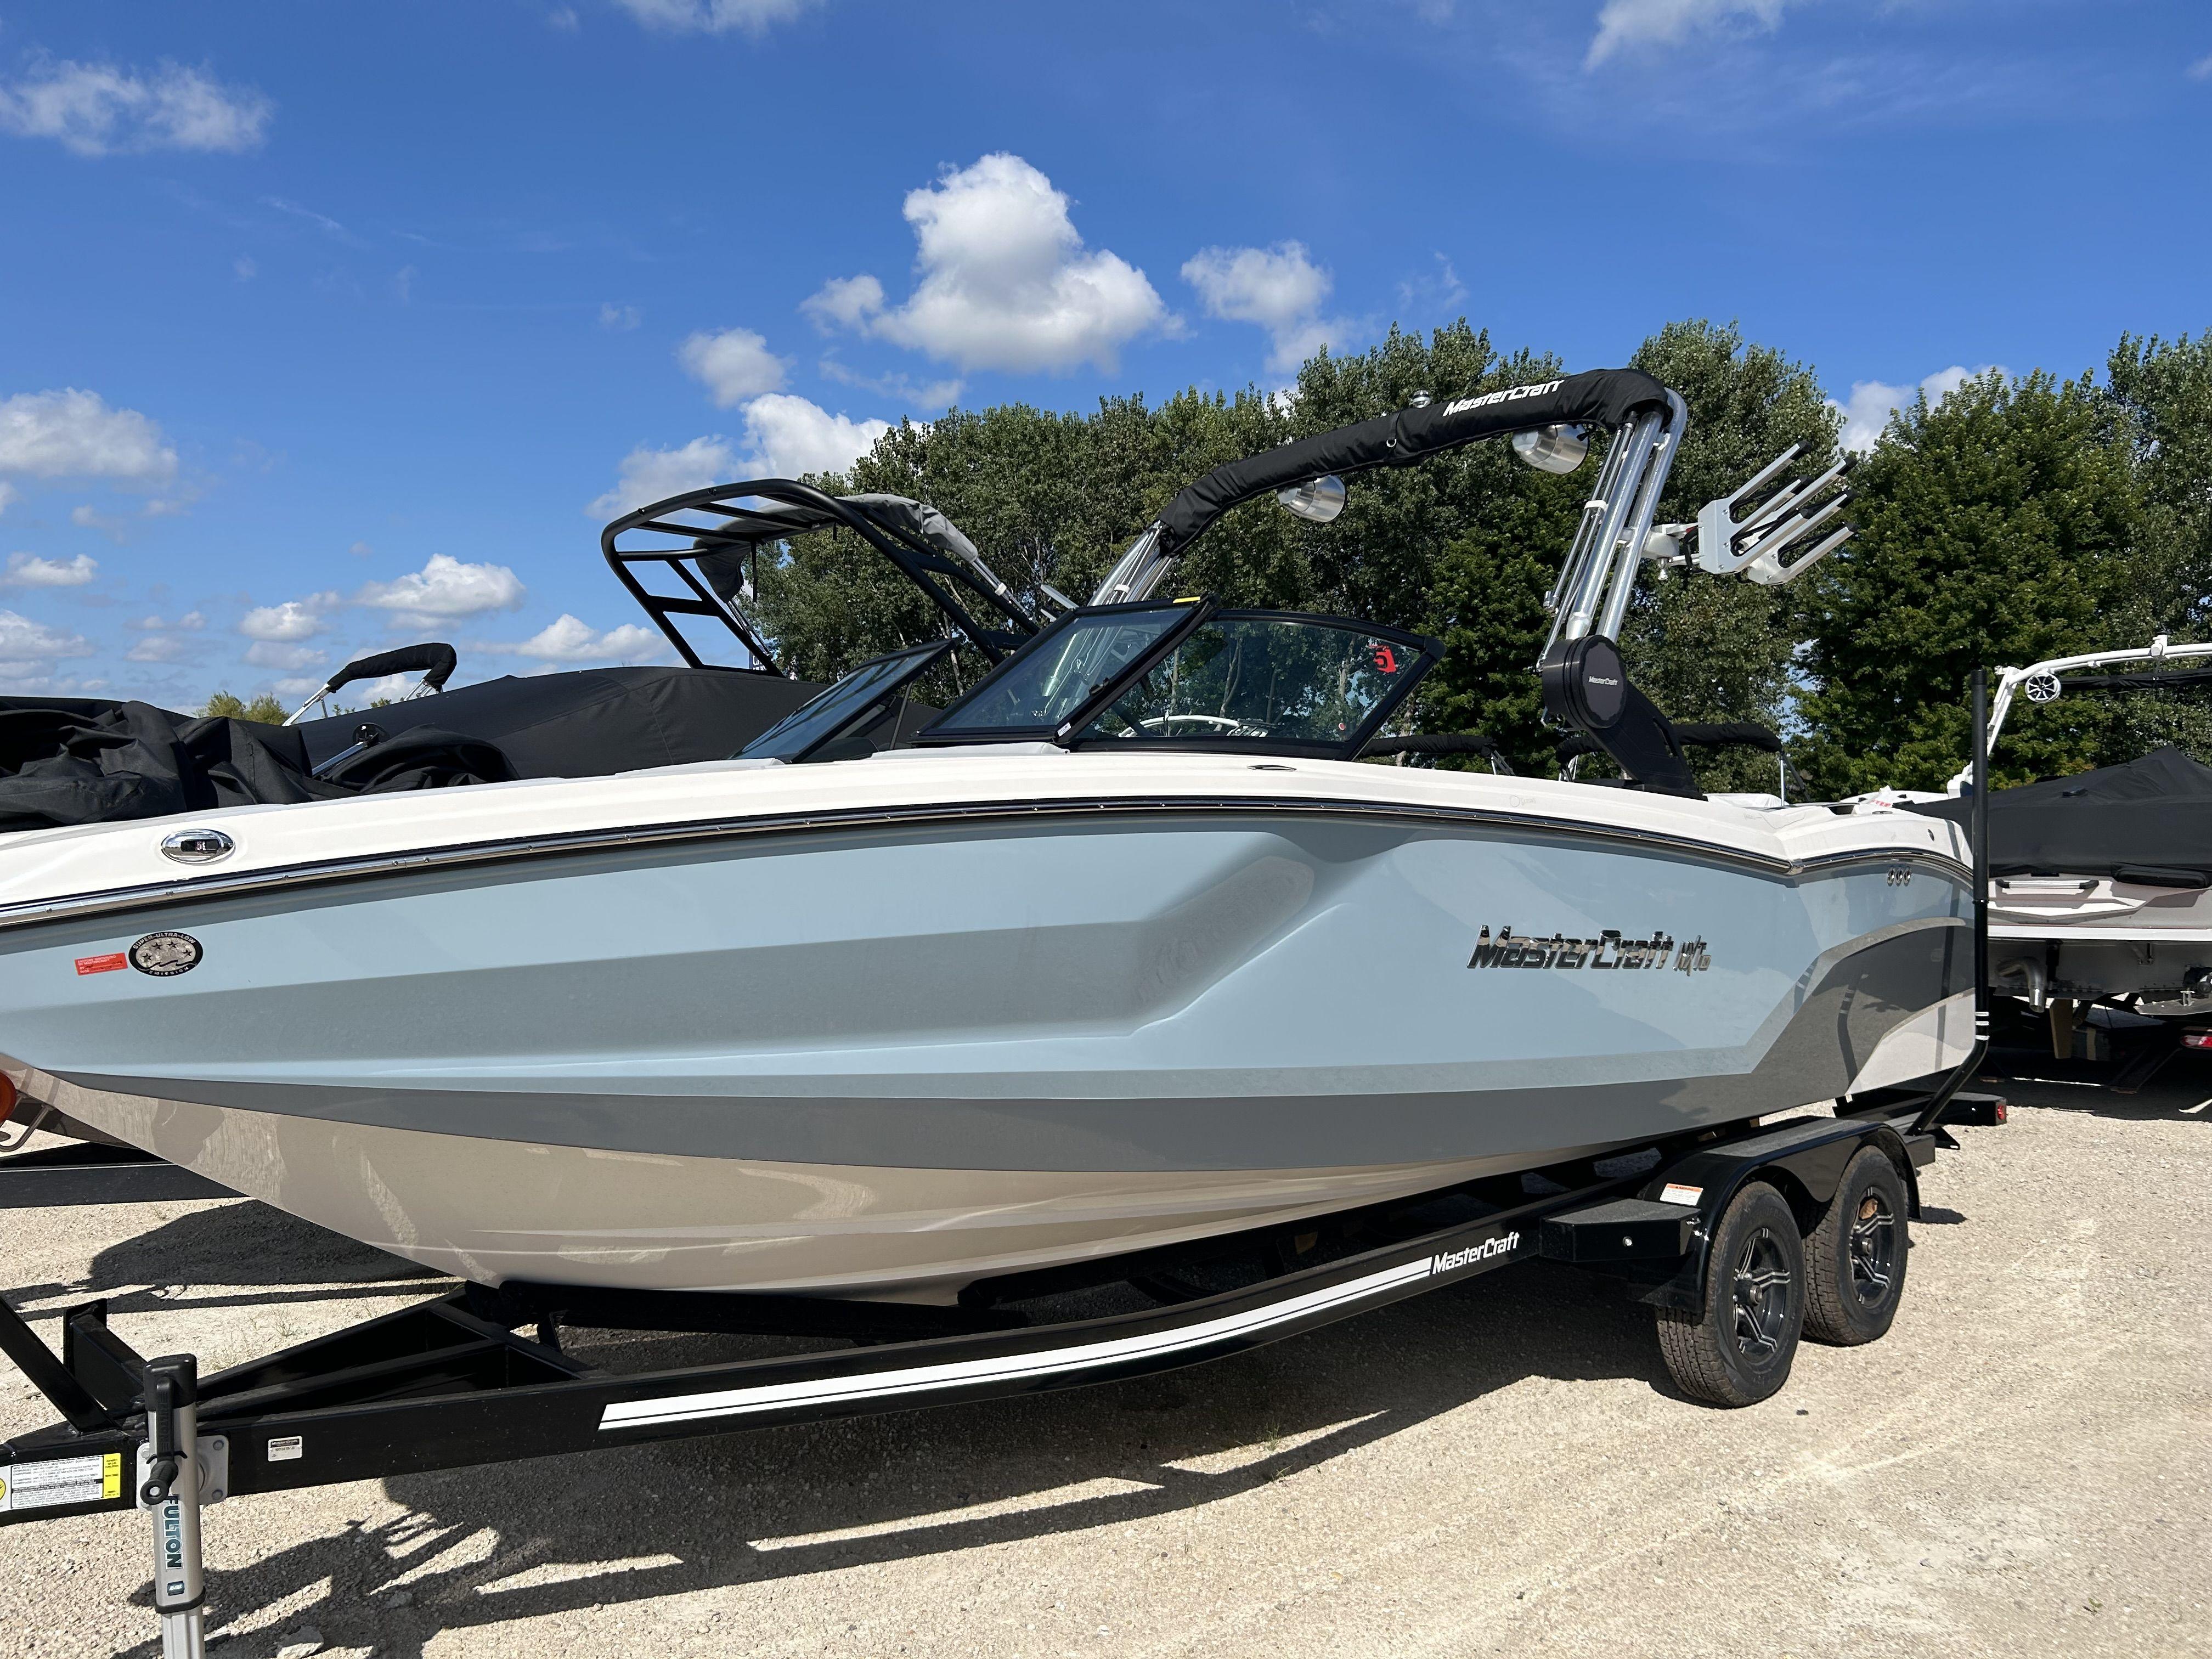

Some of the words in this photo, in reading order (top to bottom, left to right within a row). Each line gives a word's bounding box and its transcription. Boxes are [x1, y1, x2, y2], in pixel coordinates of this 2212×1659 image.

[1442, 380, 1565, 417] MasterCraft
[1589, 676, 1618, 686] MasterCraft
[1467, 924, 1674, 969] MasterCraft
[1432, 1231, 1520, 1274] MasterCraft
[163, 1494, 183, 1569] FULTON
